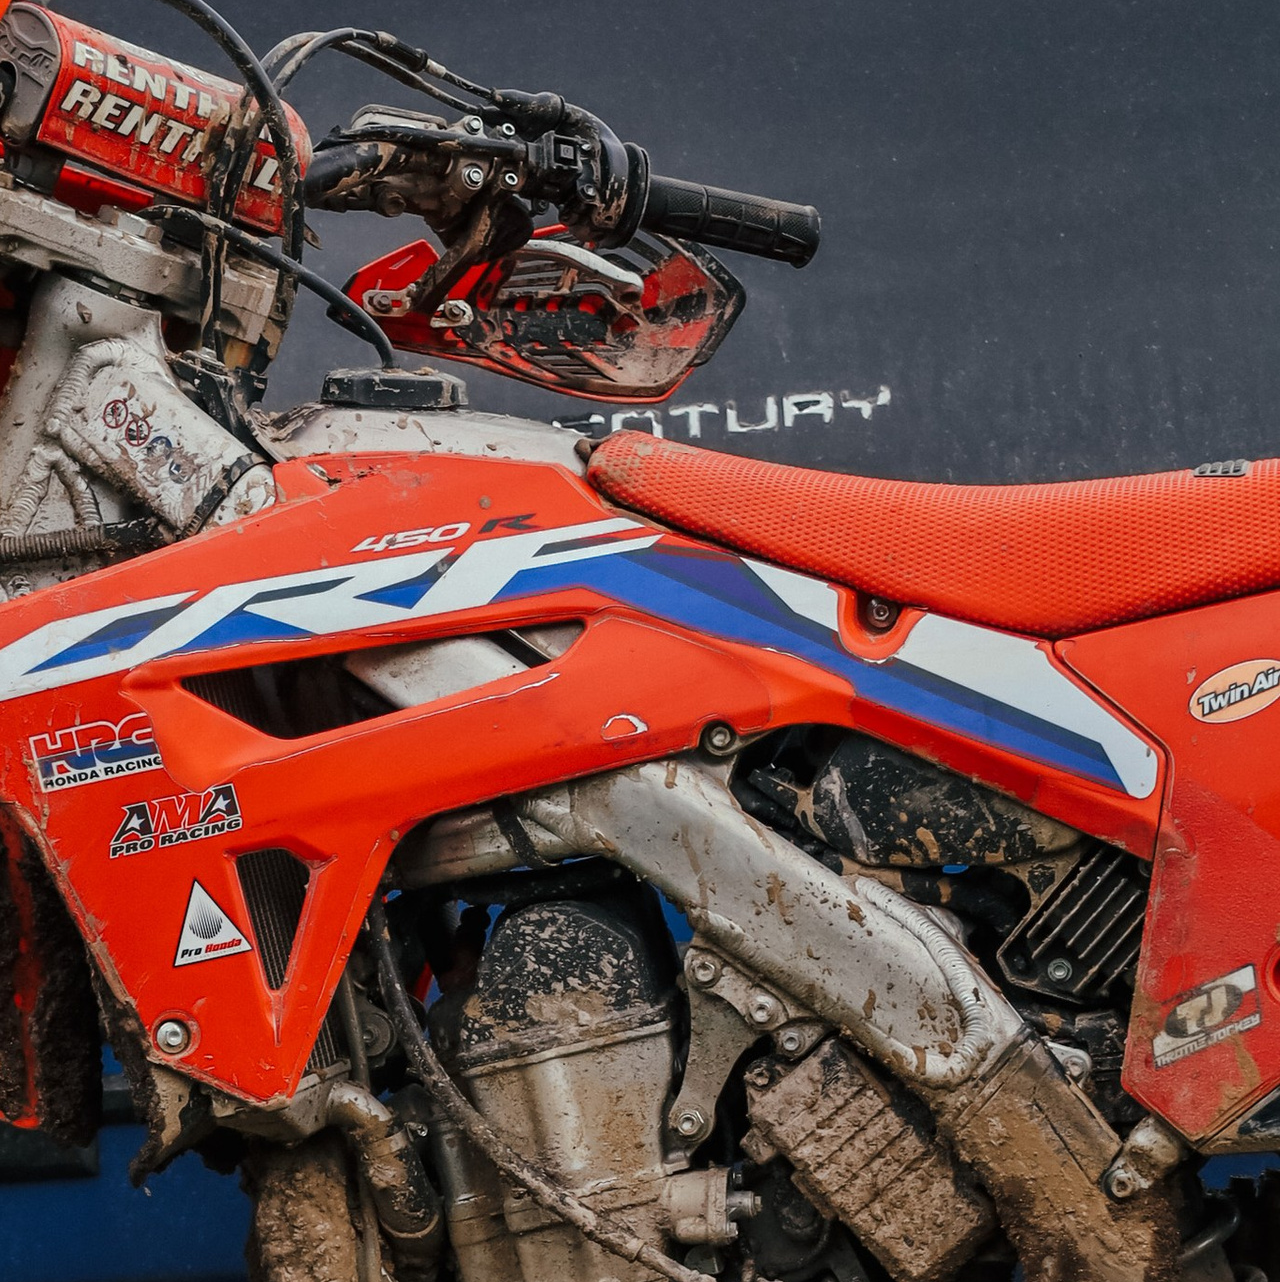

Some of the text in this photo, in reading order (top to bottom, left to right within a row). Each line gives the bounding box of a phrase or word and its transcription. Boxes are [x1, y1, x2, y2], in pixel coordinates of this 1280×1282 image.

[349, 522, 472, 552] 450
[1197, 682, 1251, 717] Twin
[43, 755, 163, 790] HONDA RACING
[110, 783, 241, 845] AMA
[110, 818, 242, 857] PRO RACING
[180, 947, 203, 959] Pro
[204, 938, 243, 954] Honda
